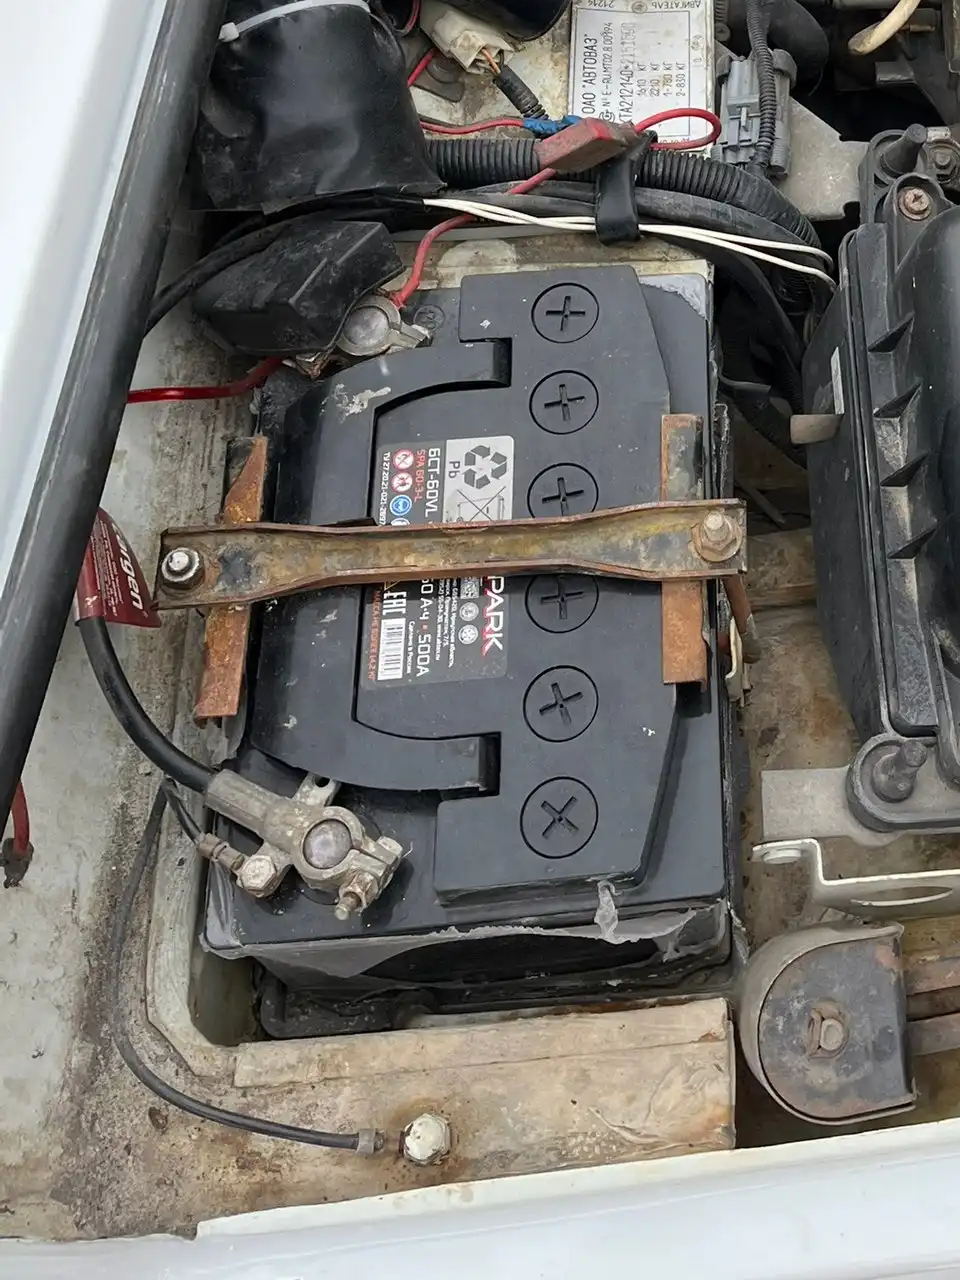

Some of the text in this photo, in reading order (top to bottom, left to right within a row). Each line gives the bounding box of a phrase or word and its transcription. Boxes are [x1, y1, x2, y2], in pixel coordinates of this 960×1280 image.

[587, 0, 701, 9] ДВИГАТЕЛЬ 21214
[581, 92, 596, 115] ОАО
[416, 449, 426, 469] SPA
[448, 461, 461, 479] Pb
